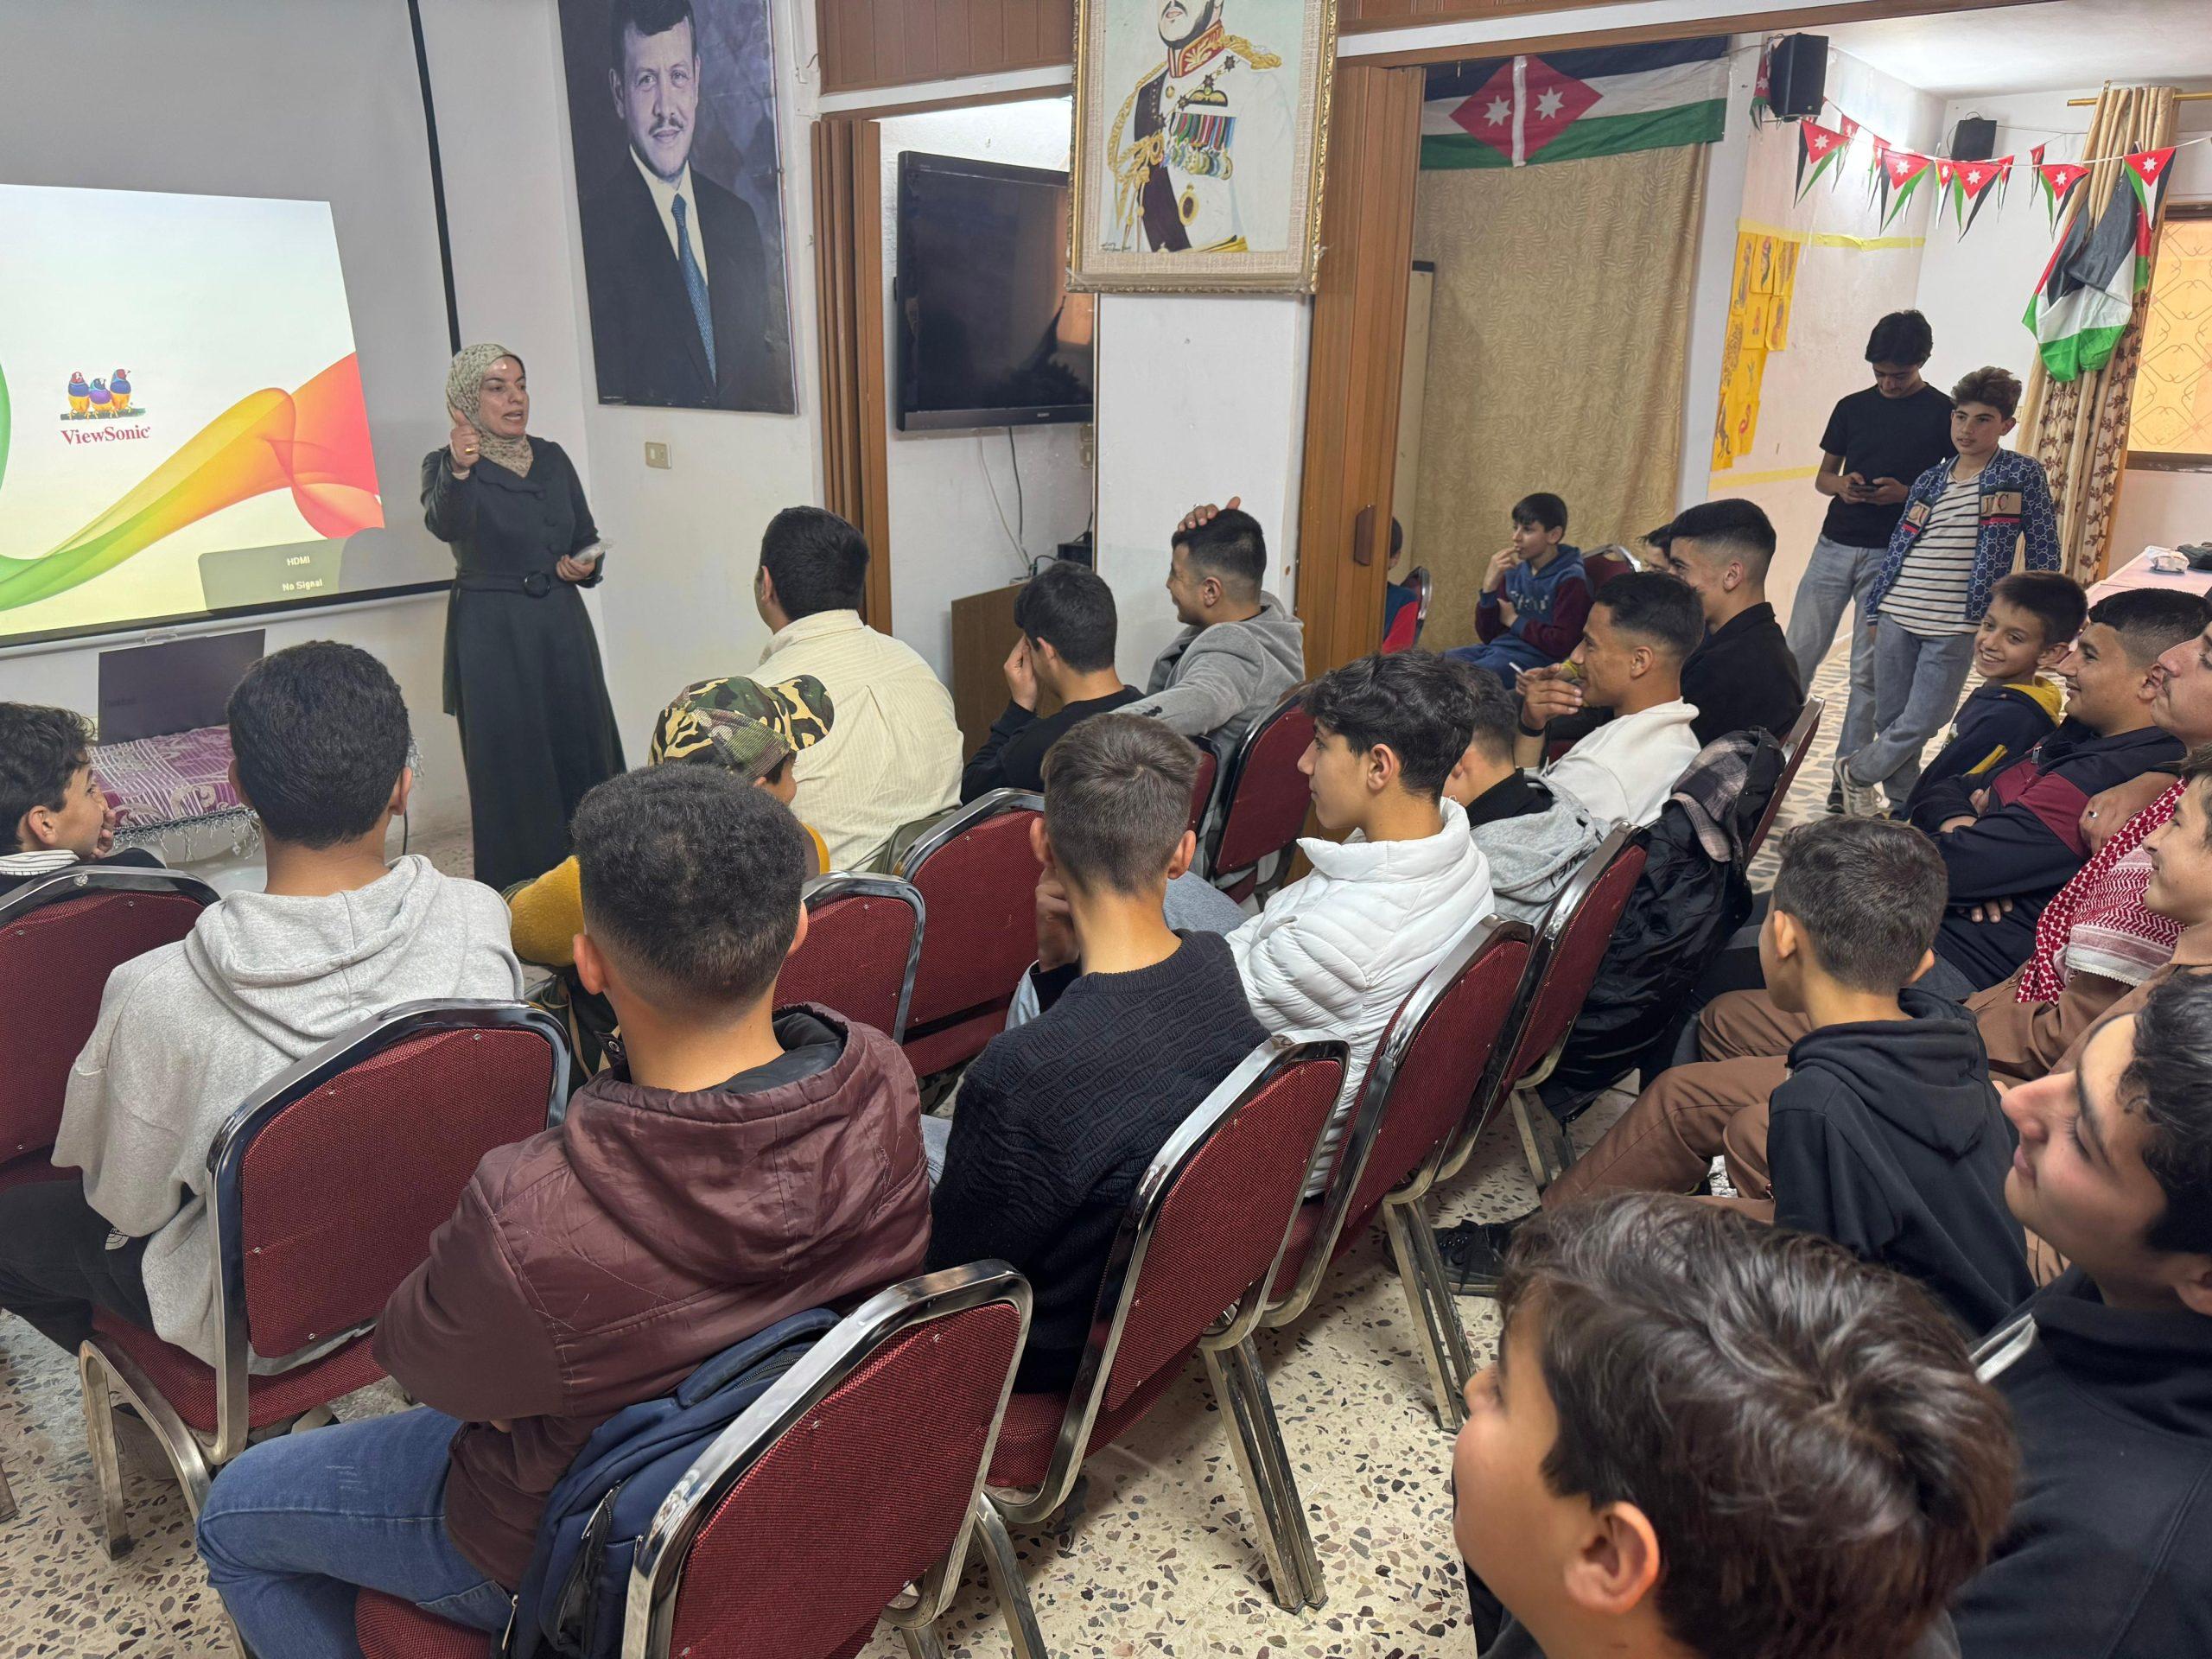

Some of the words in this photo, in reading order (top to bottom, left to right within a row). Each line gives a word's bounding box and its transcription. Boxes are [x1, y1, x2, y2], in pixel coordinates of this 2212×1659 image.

[60, 424, 150, 445] ViewSonic
[287, 556, 310, 566] HDMI
[283, 582, 295, 592] No
[296, 578, 323, 591] Signal
